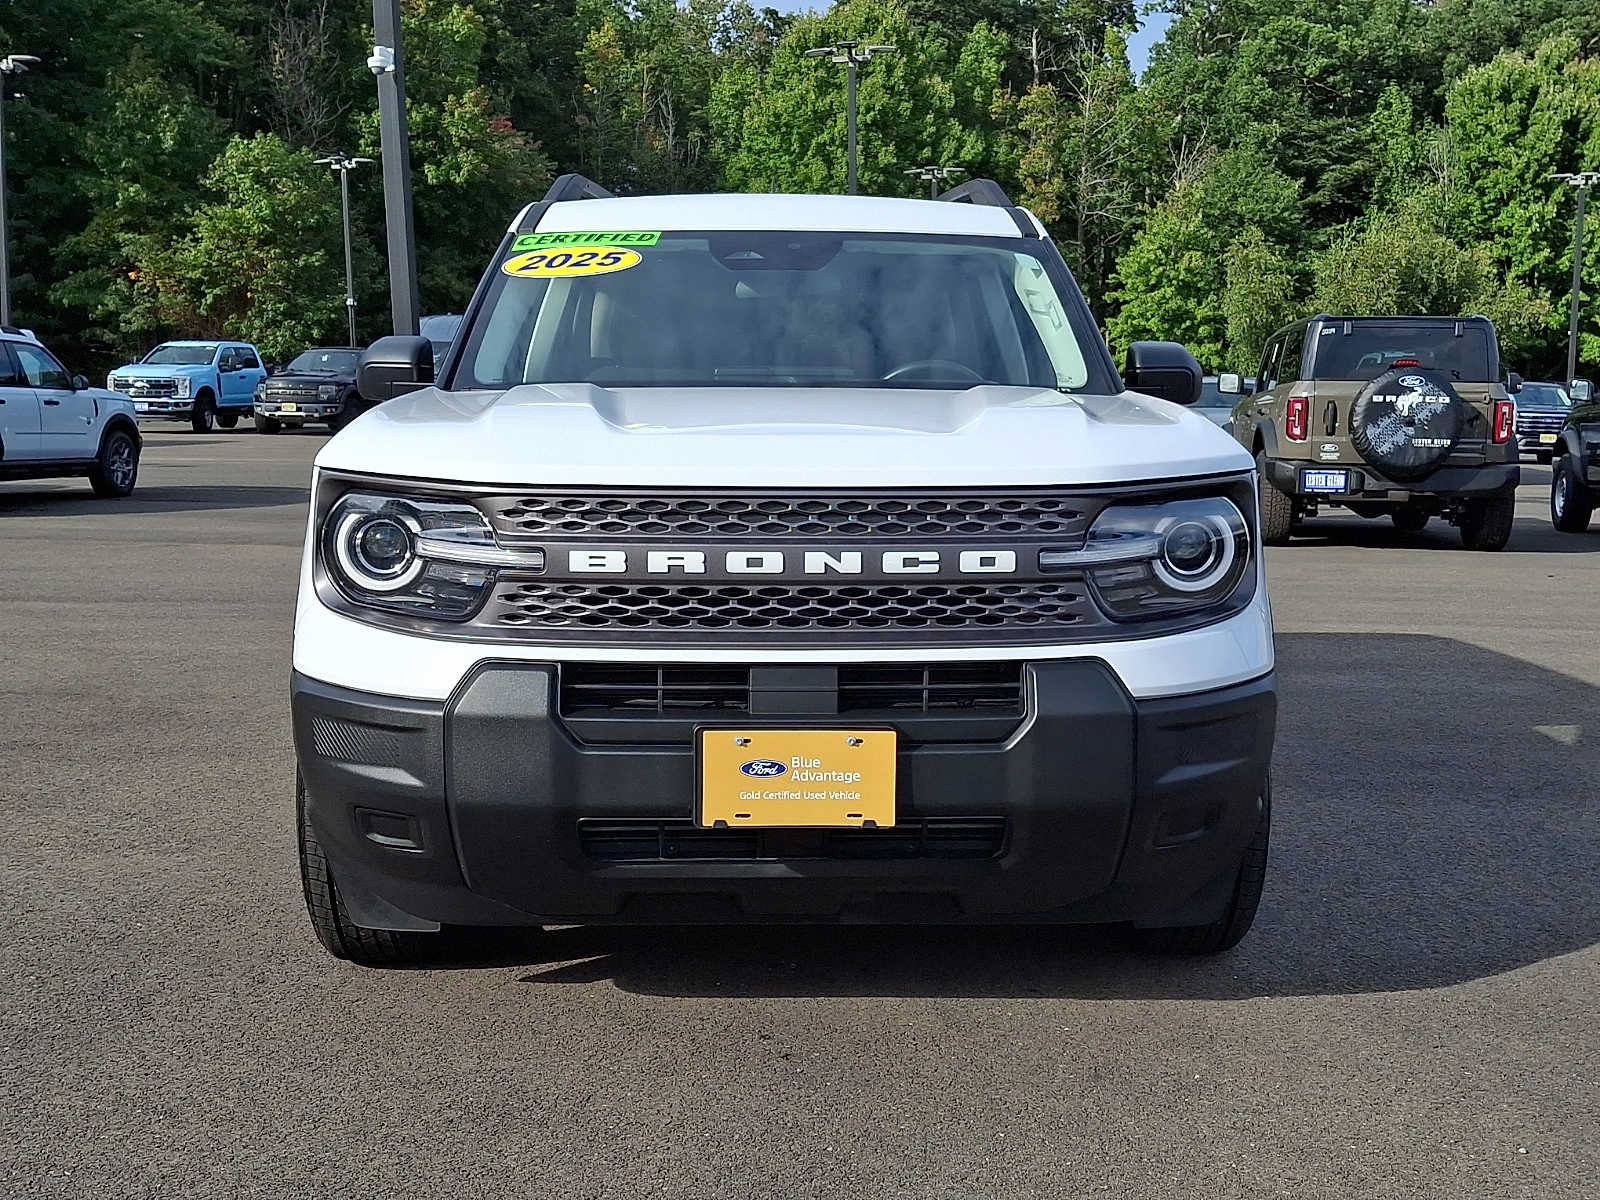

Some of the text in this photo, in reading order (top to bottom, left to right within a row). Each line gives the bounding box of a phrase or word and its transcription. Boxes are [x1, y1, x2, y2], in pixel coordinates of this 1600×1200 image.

[517, 233, 656, 246] CERTIFIED
[516, 252, 627, 272] 2025
[1372, 394, 1450, 403] BRCO
[568, 550, 1017, 574] BRONCO
[747, 760, 780, 776] Ford
[791, 756, 821, 769] Blue
[791, 771, 861, 784] Advantage
[739, 791, 861, 800] Gold Certified Used Vehicle
